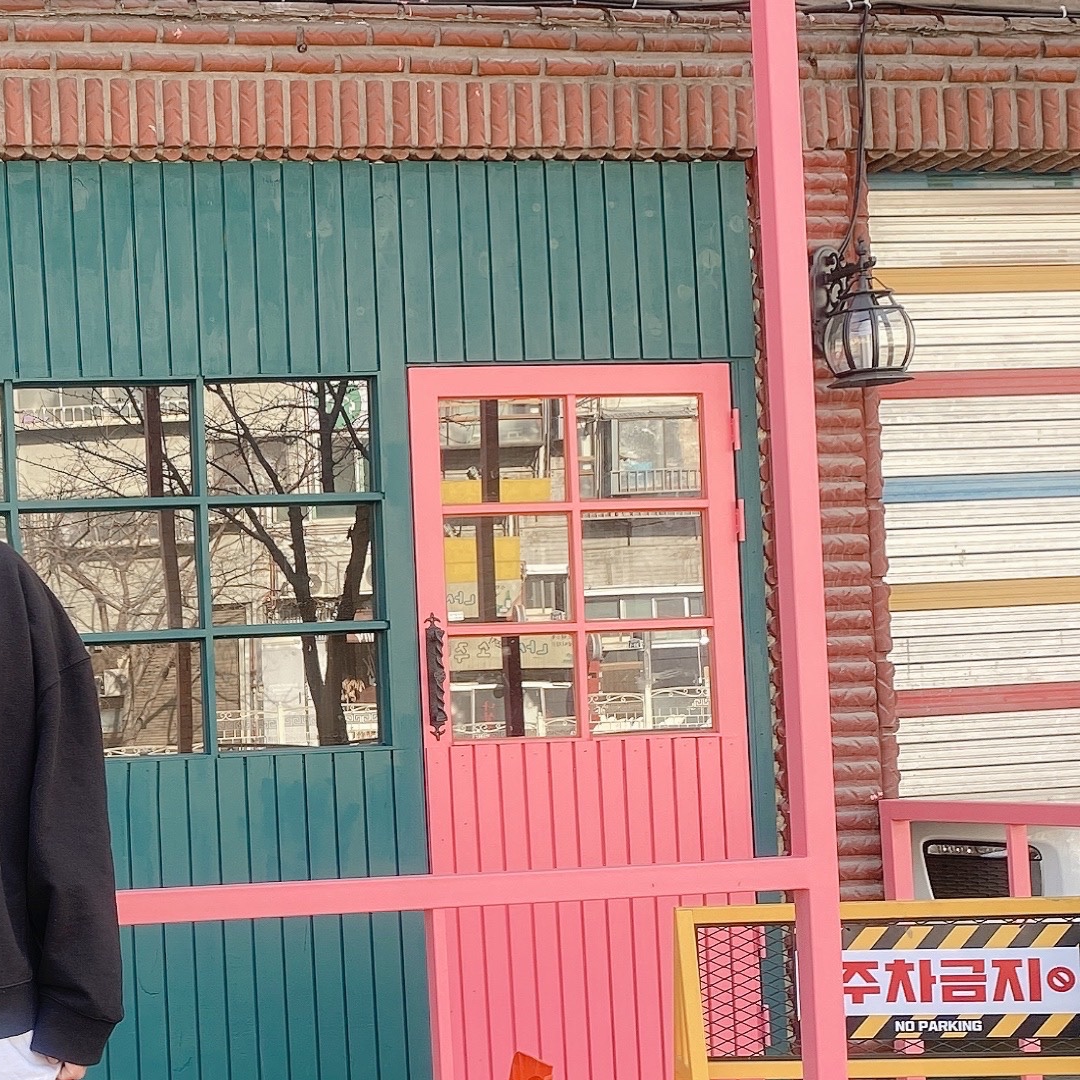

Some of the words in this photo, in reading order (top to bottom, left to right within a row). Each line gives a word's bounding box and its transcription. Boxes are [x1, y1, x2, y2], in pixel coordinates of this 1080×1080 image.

[842, 958, 1042, 1004] 주차금지
[894, 1020, 916, 1033] NO
[920, 1020, 984, 1032] PARKING
